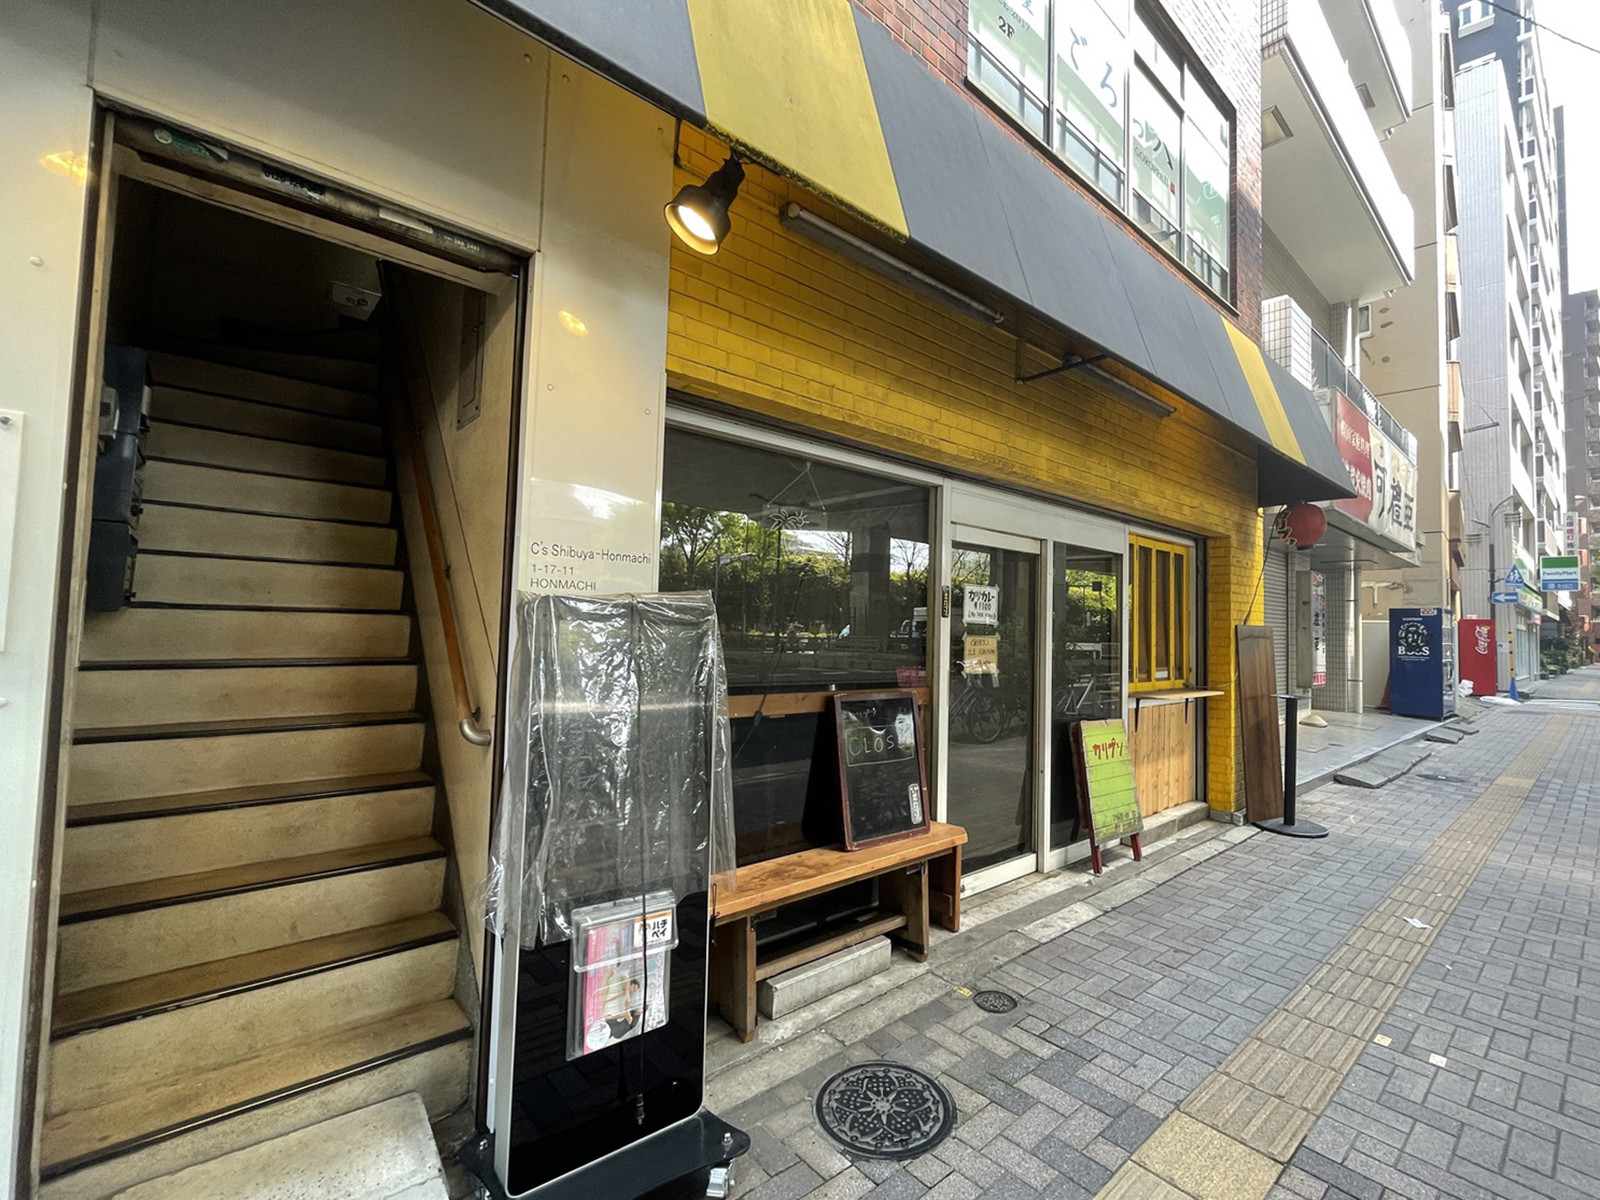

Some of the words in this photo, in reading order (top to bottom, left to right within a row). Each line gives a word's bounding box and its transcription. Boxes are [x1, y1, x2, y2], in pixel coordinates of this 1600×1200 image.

[998, 15, 1015, 39] 2F
[530, 541, 548, 556] C's
[551, 543, 651, 564] Shibuya-Honmachi
[532, 563, 574, 575] 1-17-11
[530, 578, 597, 591] HONMACHI
